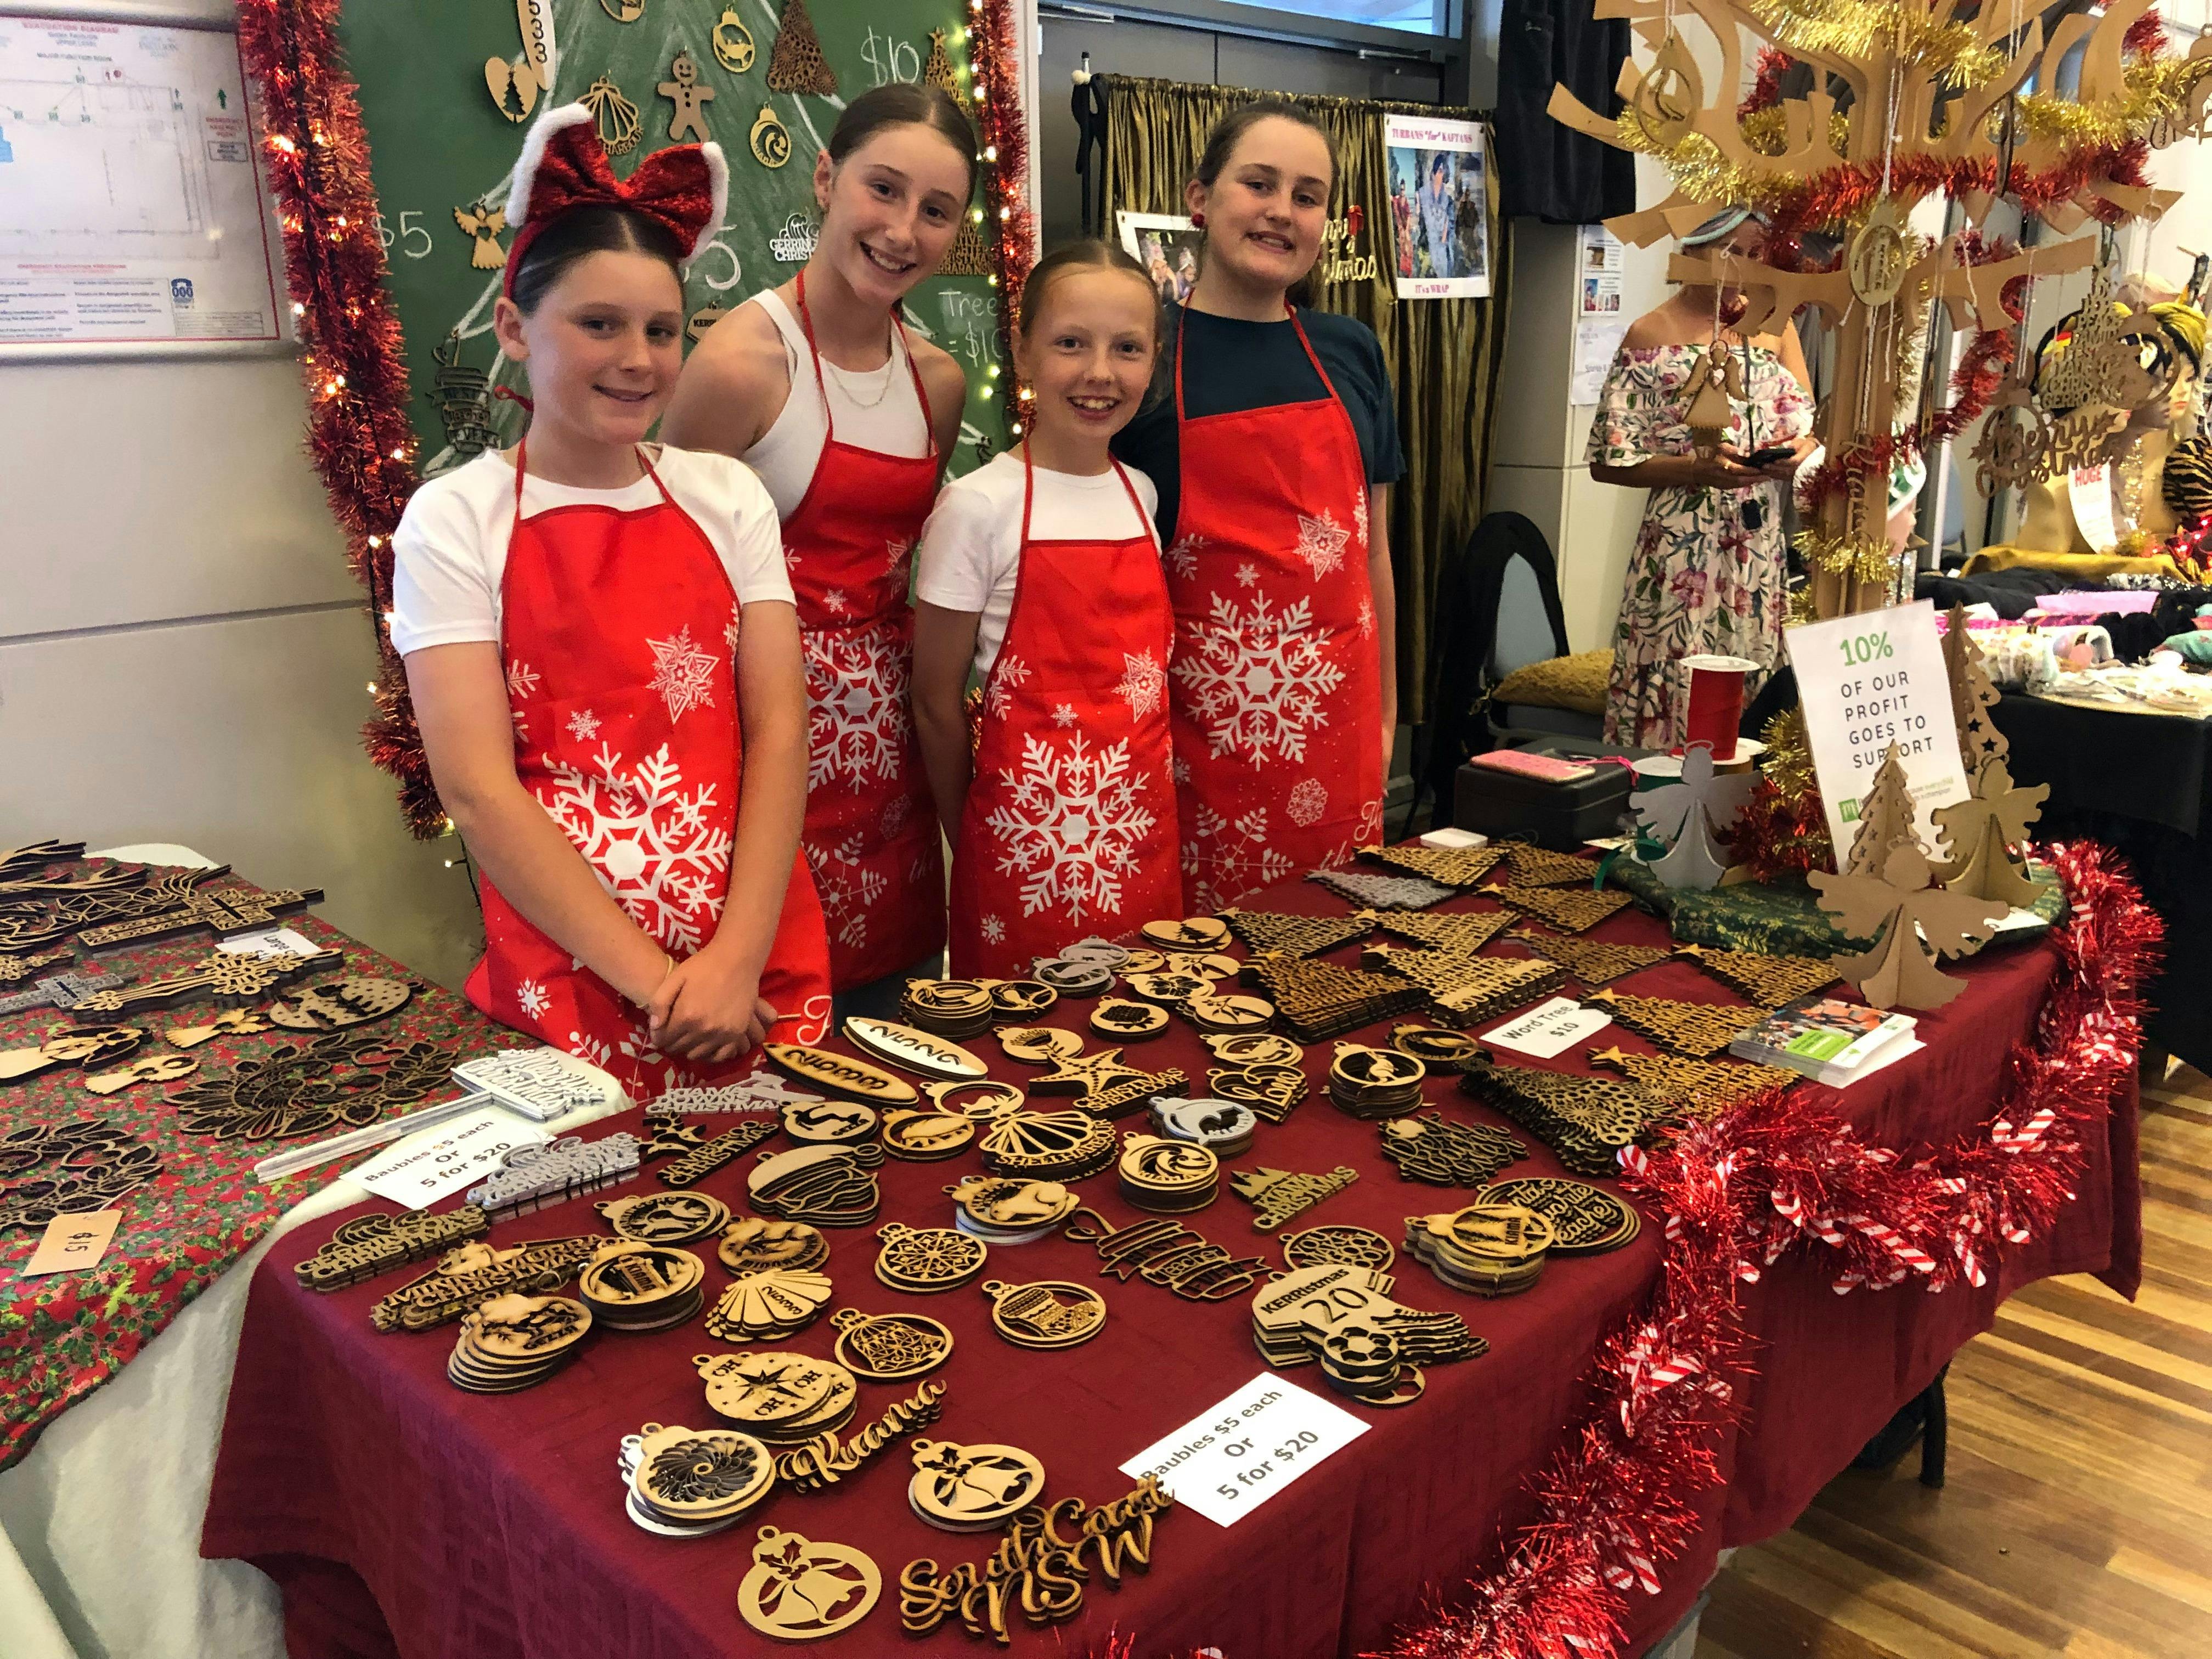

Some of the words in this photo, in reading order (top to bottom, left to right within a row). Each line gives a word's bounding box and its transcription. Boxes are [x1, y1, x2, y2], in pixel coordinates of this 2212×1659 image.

[860, 25, 920, 88] $10
[938, 291, 998, 318] Tree
[2075, 464, 2102, 487] HUGE
[1840, 631, 1893, 666] 10%
[1841, 680, 1863, 698] OF
[1872, 671, 1909, 691] OUR
[1844, 695, 1909, 721] PROFIT
[1849, 722, 1895, 745] GOES
[1904, 715, 1926, 732] TO
[1852, 736, 1933, 769] SUPORT
[1501, 1019, 1544, 1040] Word
[1537, 1006, 1573, 1022] Tree
[1549, 1022, 1579, 1037] $10
[1072, 1068, 1184, 1107] CHRISTMAS
[645, 1099, 780, 1114] CHRISTMA
[364, 1149, 432, 1182] Baubles
[457, 1120, 493, 1139] each
[435, 1149, 460, 1164] Or
[657, 1120, 759, 1179] JAMBEROO
[668, 1122, 779, 1184] CHRISTMAS
[995, 1119, 1117, 1167] SHELLHARBOUR
[420, 1178, 437, 1188] 5
[438, 1161, 469, 1180] for
[472, 1142, 512, 1163] $20
[1301, 1288, 1369, 1324] 20
[1140, 1431, 1215, 1482] Baubles
[1214, 1414, 1241, 1437] $5
[1243, 1389, 1283, 1421] each
[1223, 1435, 1256, 1459] Or
[1215, 1482, 1239, 1503] 5
[1236, 1458, 1274, 1487] for
[1273, 1430, 1319, 1463] $20
